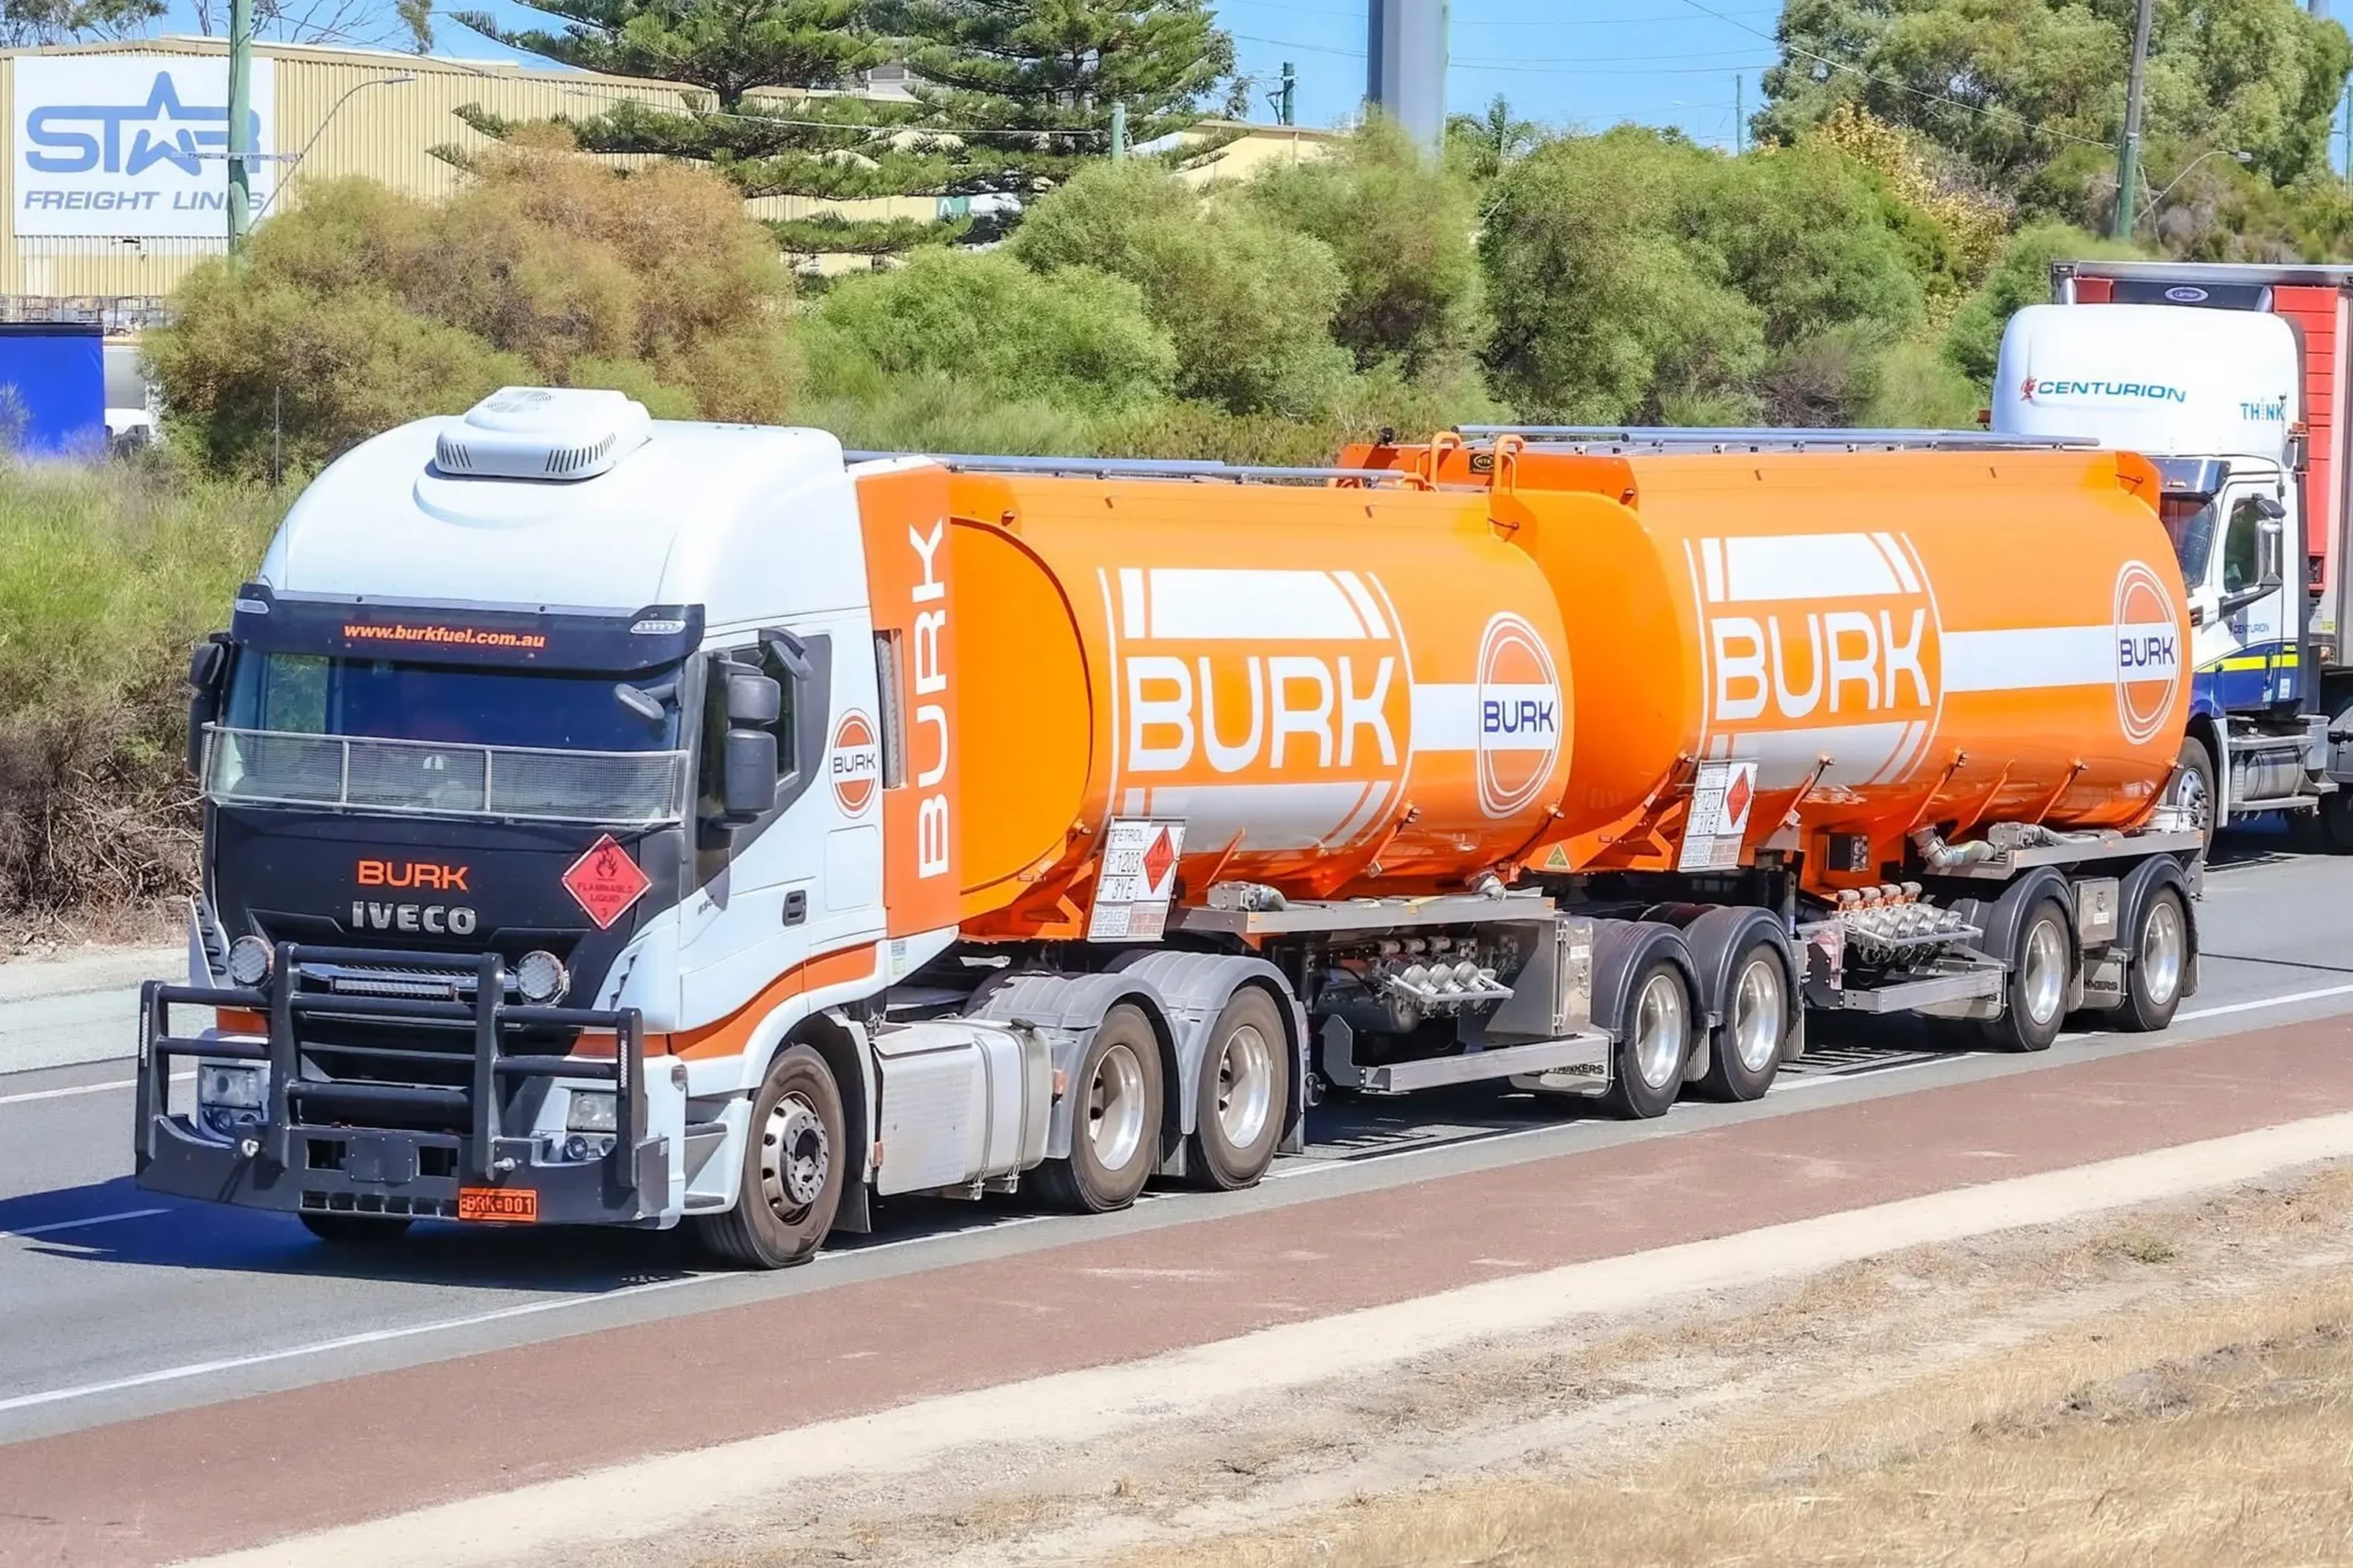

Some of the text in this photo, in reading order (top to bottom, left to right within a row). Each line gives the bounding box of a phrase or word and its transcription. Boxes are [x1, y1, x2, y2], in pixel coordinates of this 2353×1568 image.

[26, 71, 261, 176] STAR
[24, 190, 265, 210] FREIGHT LINS
[2038, 381, 2187, 403] CENTURION
[343, 623, 546, 648] www.burkfuel.com.au
[2120, 636, 2176, 666] BURK
[1710, 608, 1932, 721] BURK
[909, 517, 950, 880] BURK
[1126, 656, 1398, 773] BURK
[1483, 700, 1555, 733] BURK
[833, 753, 877, 774] BURK
[358, 860, 470, 892] BURK
[1118, 852, 1141, 872] 1203
[352, 901, 477, 935] IVECO
